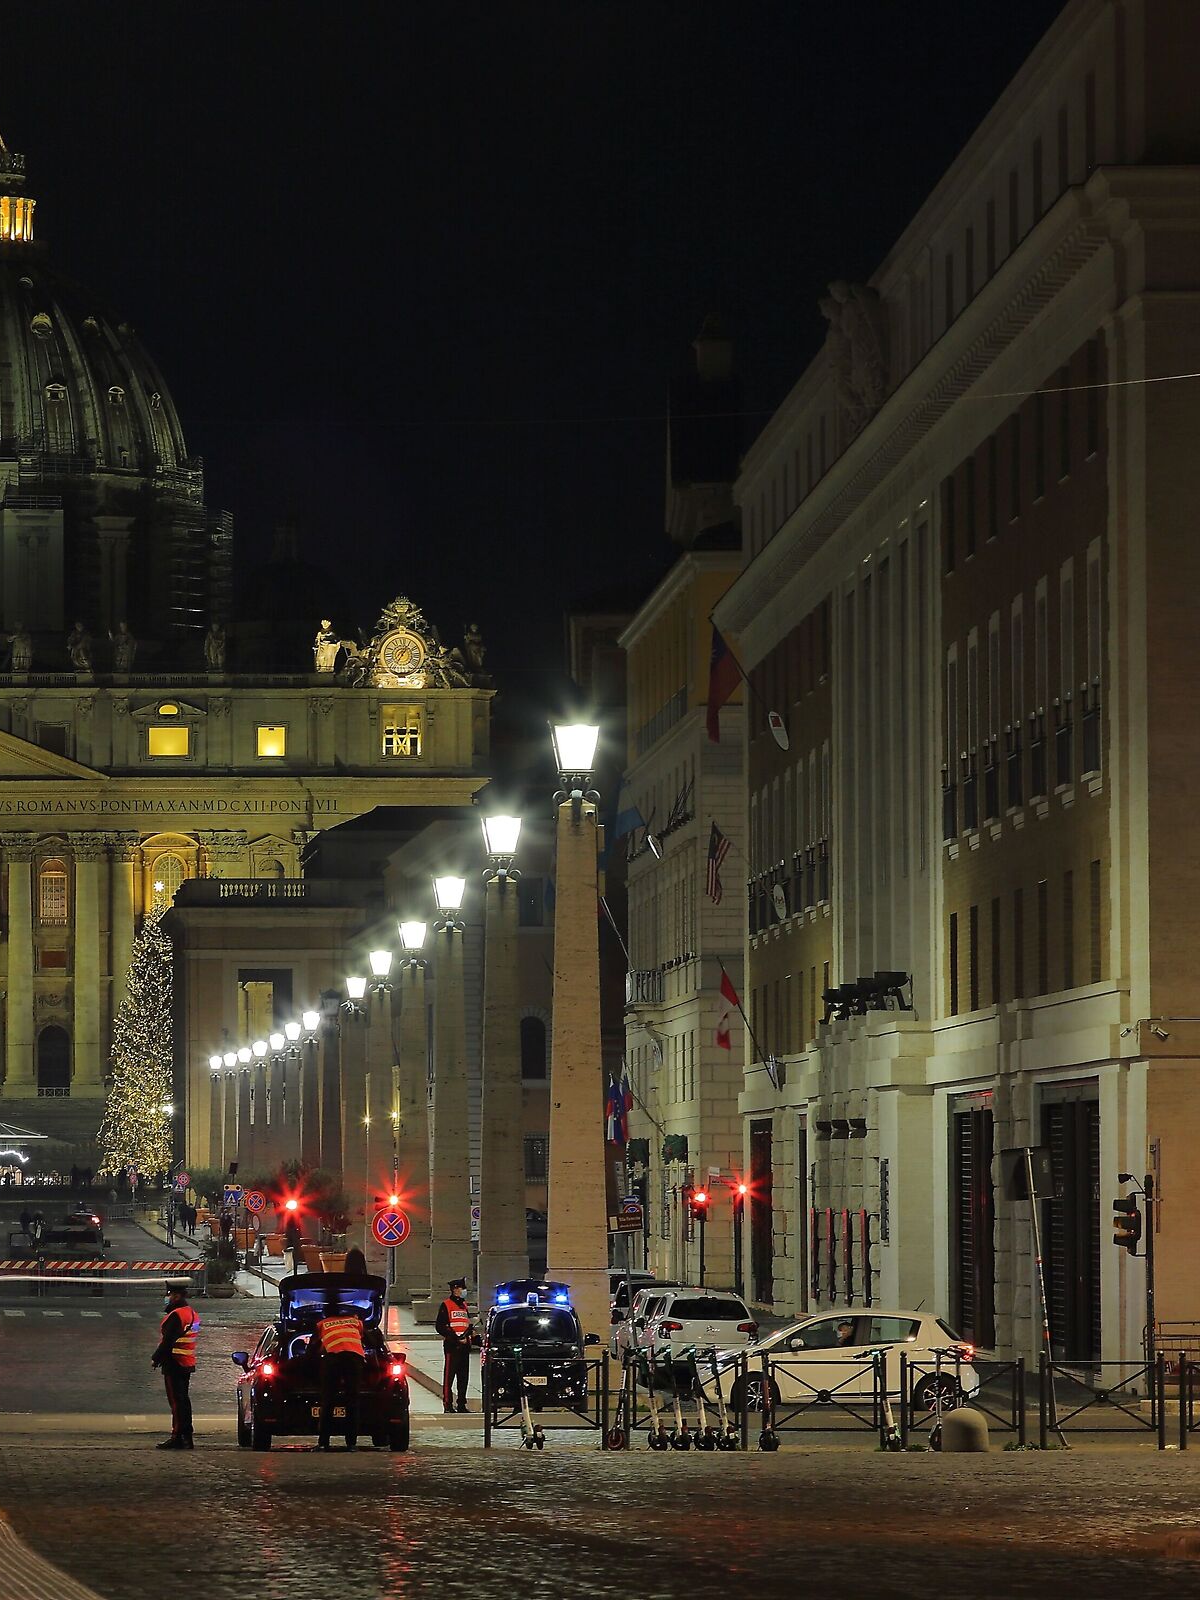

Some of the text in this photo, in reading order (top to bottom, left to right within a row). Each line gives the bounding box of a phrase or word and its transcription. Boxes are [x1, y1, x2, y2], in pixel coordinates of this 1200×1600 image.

[16, 800, 96, 812] ROMANVS
[178, 800, 199, 811] AN
[203, 800, 265, 811] MDCXII
[270, 799, 311, 811] PONT
[316, 799, 338, 810] VII
